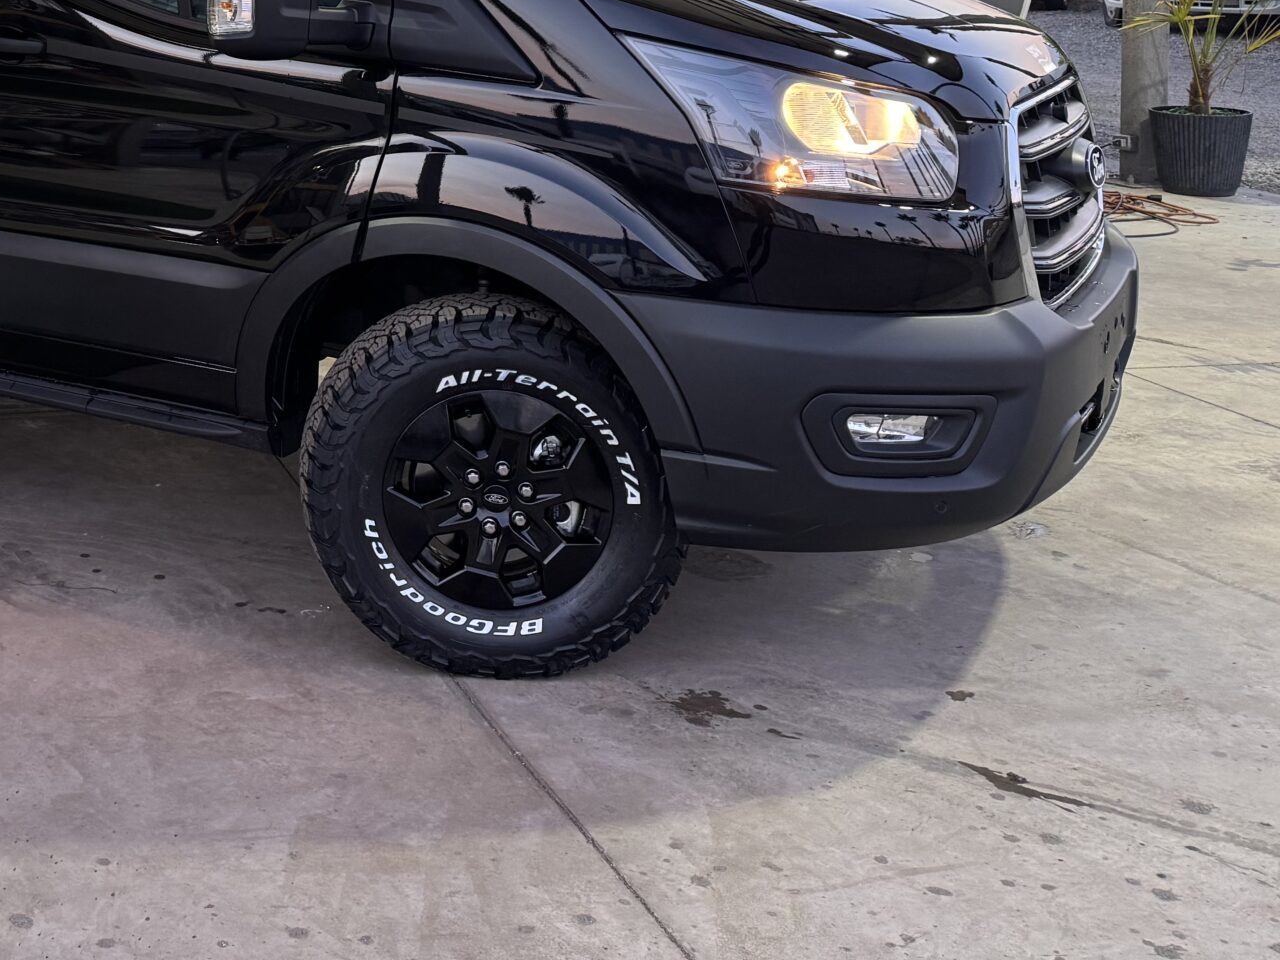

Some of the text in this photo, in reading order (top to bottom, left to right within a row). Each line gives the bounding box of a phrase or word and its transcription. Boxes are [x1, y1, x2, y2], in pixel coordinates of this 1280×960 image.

[435, 368, 641, 505] All-Terrain T/A
[364, 518, 543, 637] BFGoodrich
